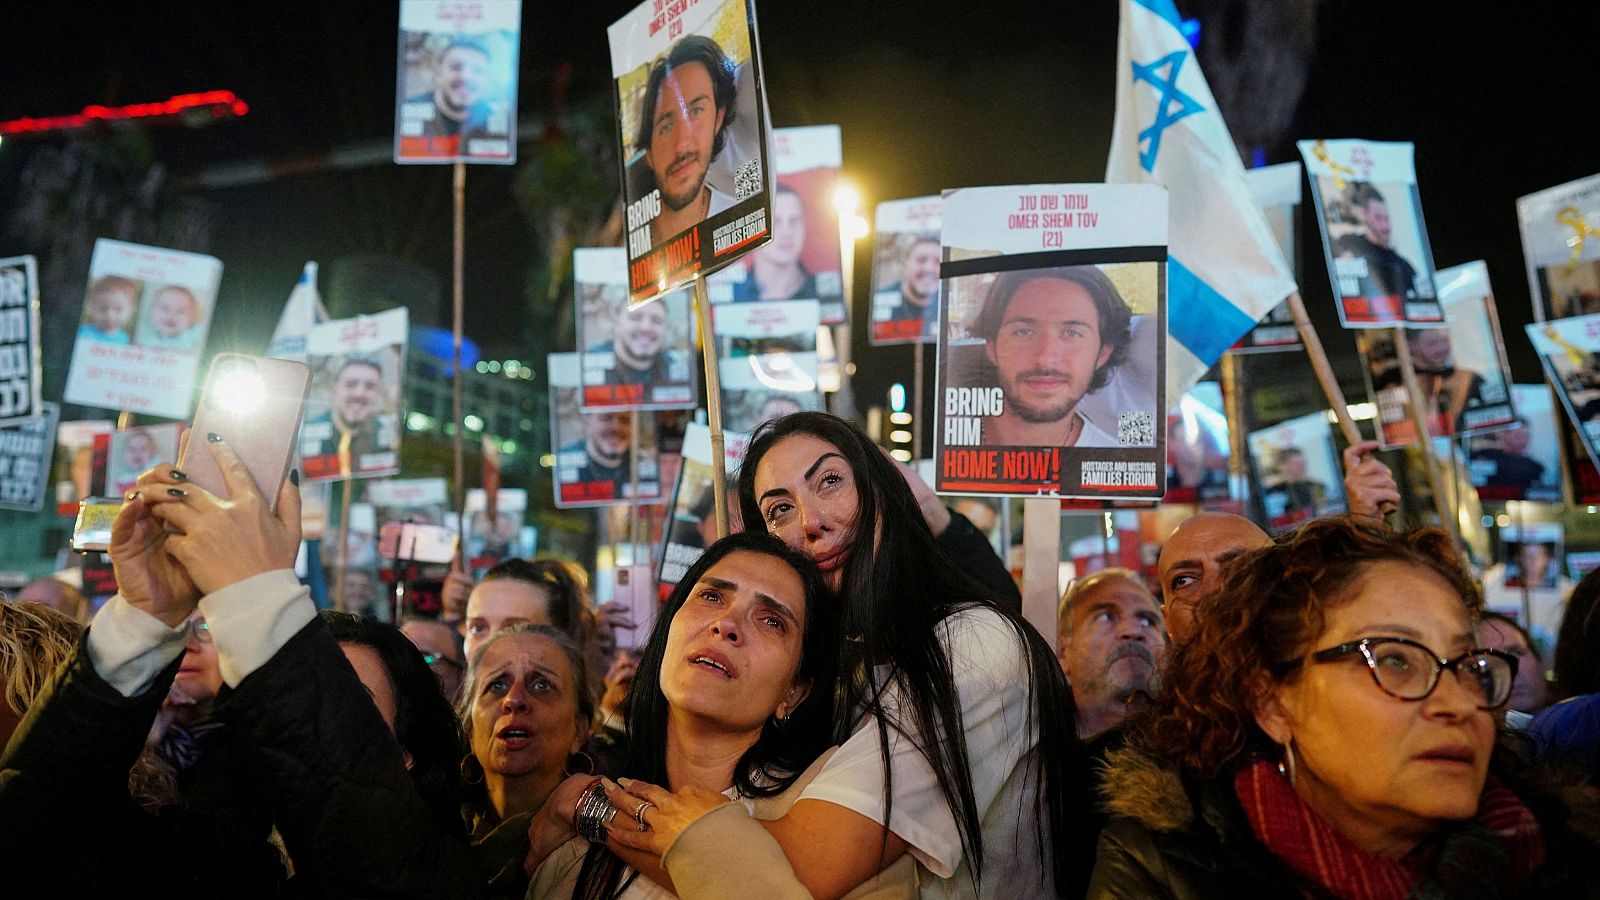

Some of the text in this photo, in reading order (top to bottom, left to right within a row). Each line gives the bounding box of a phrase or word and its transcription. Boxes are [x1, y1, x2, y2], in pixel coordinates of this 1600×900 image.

[648, 0, 688, 38] OMER SHEM
[669, 17, 683, 41] (21)
[627, 189, 661, 232] BRING
[1019, 194, 1088, 211] עומר שם טוב
[714, 217, 767, 254] FAMILIES FORUM
[1008, 213, 1098, 229] OMER SHEM TOV
[629, 222, 652, 260] HIM
[666, 226, 700, 272] NOW!
[1042, 230, 1063, 248] (21)
[945, 387, 1004, 416] BRING
[944, 417, 981, 446] HIM
[943, 447, 1060, 480] HOME NOW!
[1081, 461, 1157, 473] HOSTAGES AND MISSING
[1081, 471, 1157, 487] FAMILIES FORUM
